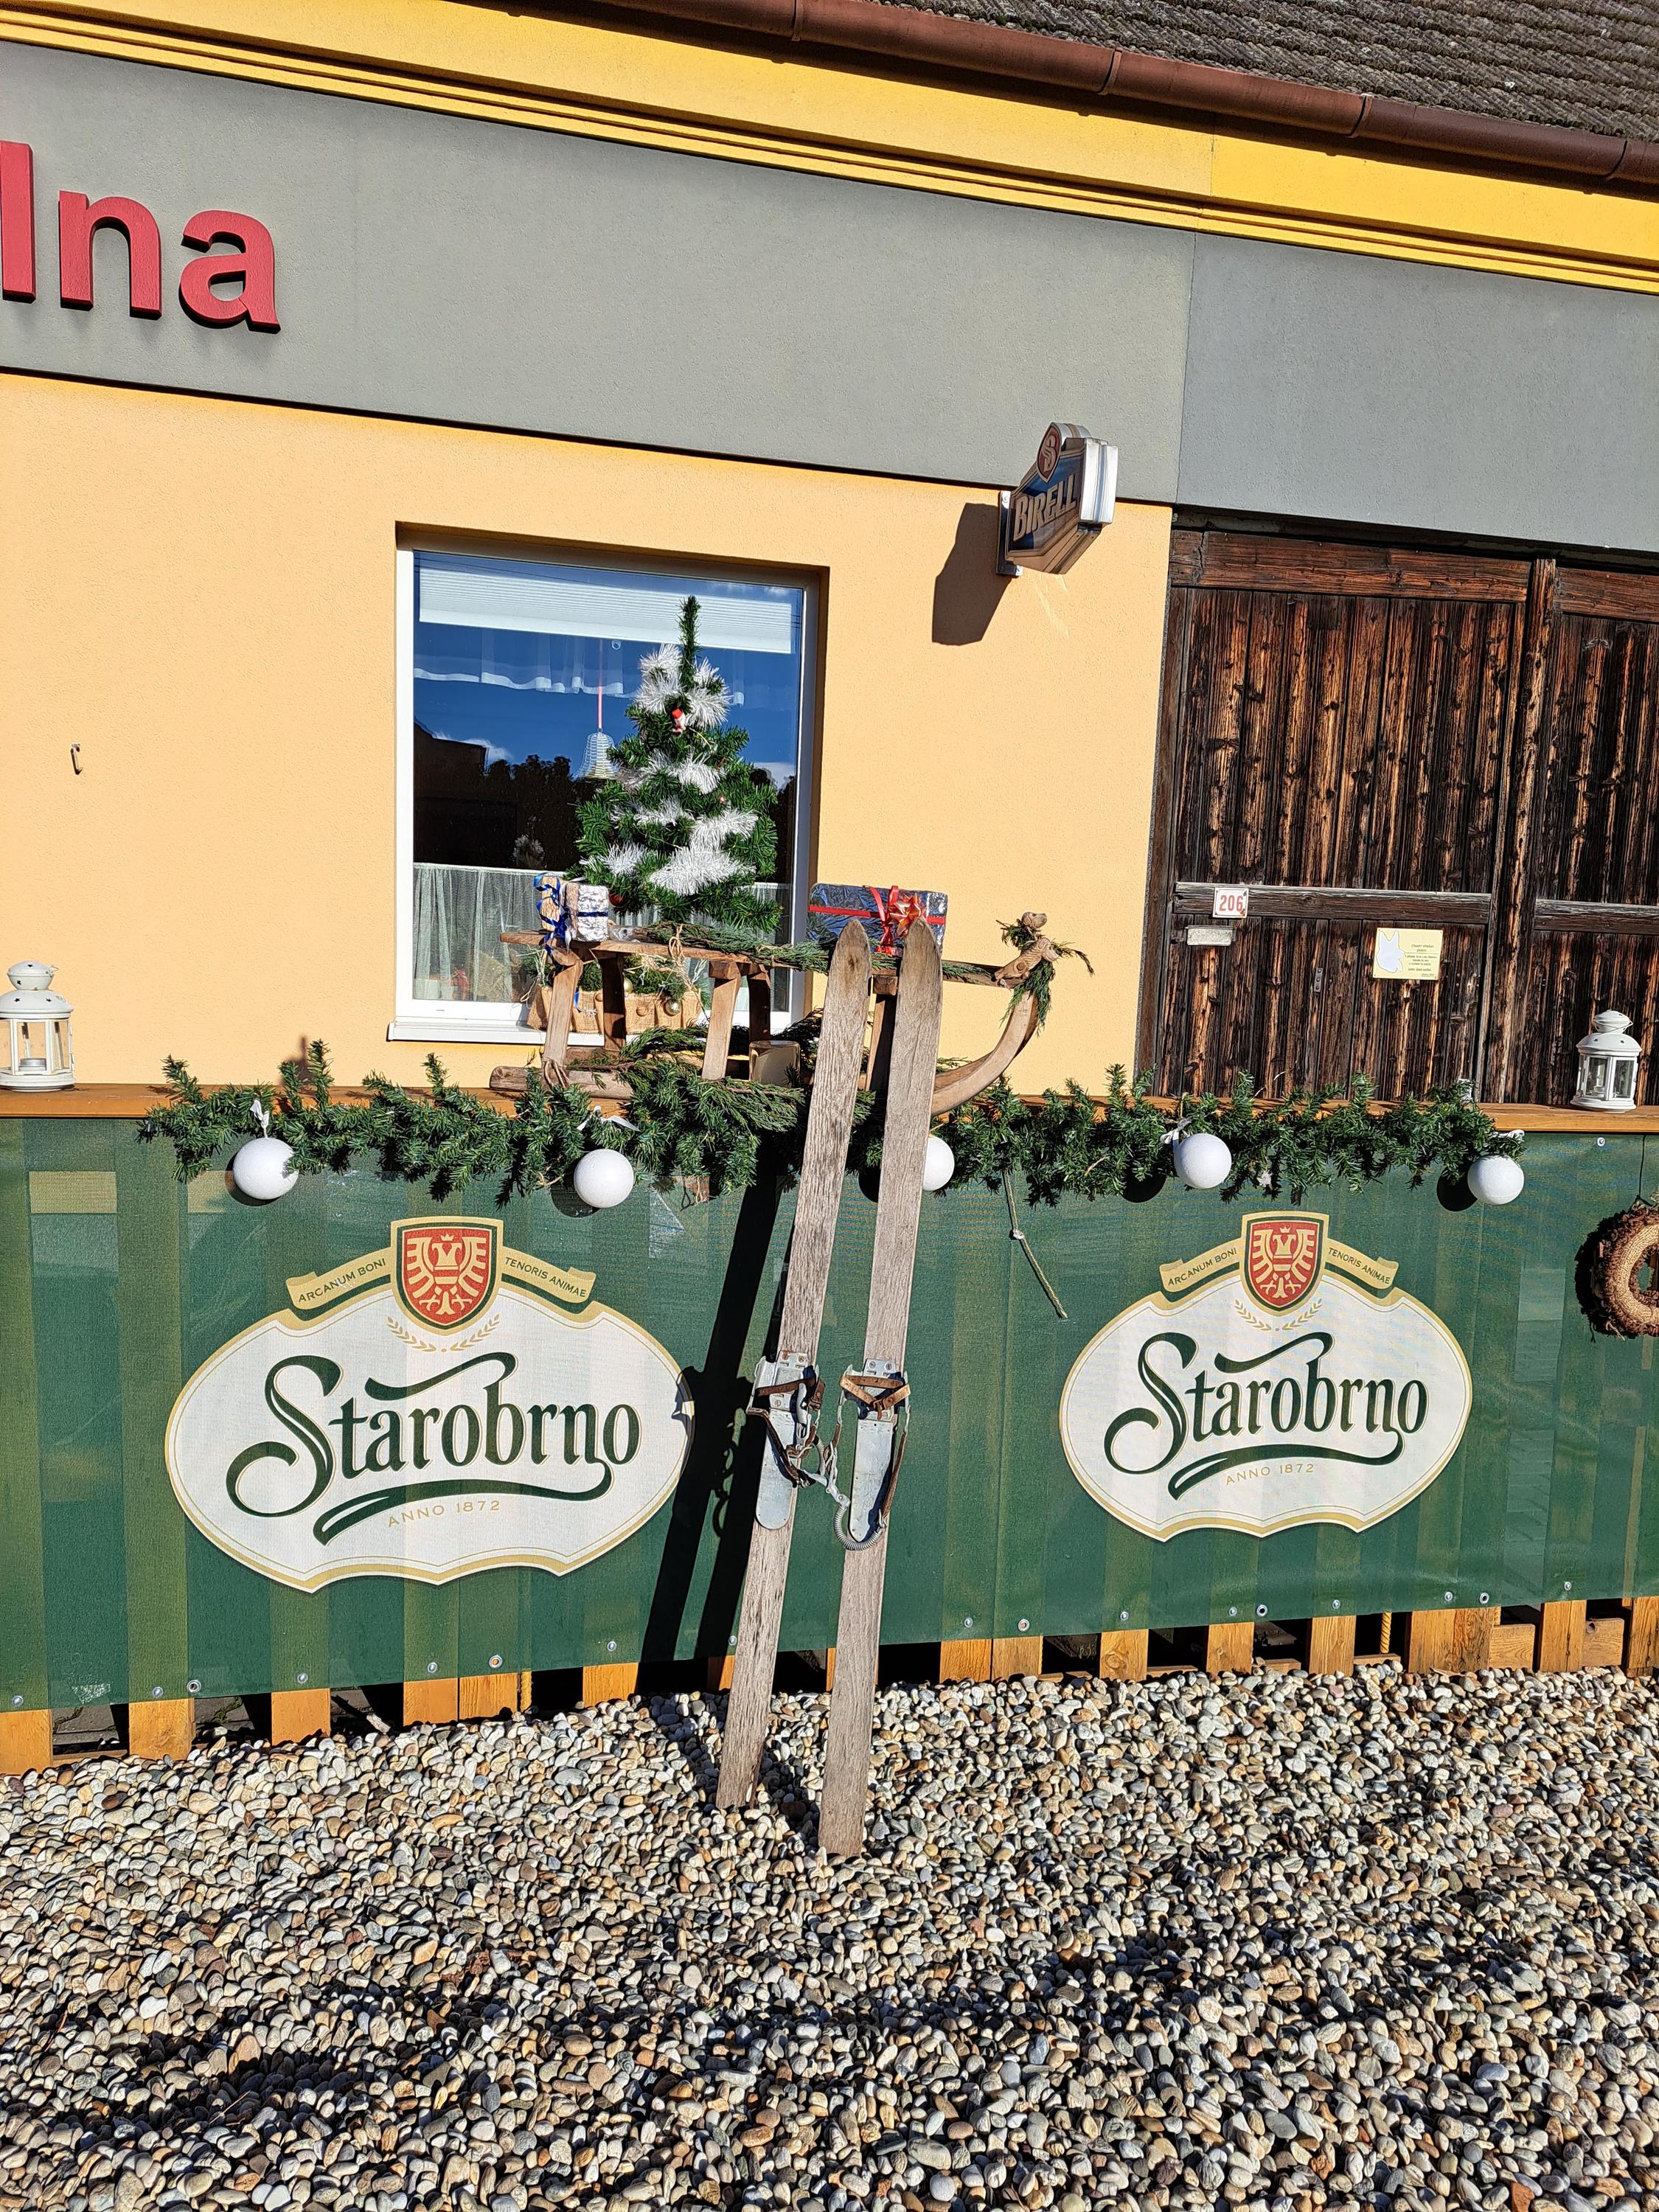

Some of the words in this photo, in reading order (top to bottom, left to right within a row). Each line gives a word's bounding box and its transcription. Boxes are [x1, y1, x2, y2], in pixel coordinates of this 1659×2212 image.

[1013, 474, 1077, 541] BIRELL
[1219, 894, 1243, 911] 206
[298, 1271, 355, 1302] ARCANUM
[357, 1258, 386, 1276] BONI
[505, 1256, 549, 1279] TENORIS
[549, 1276, 587, 1298] ANIMAE
[1168, 1259, 1213, 1286] ARCANUM
[1214, 1247, 1237, 1263] BONI
[1329, 1247, 1362, 1267] TENORIS
[1361, 1265, 1391, 1284] ANIMAE
[1104, 1332, 1428, 1501] Starobrno
[226, 1352, 640, 1546] Starobrno
[1225, 1467, 1271, 1486] ANNO
[1279, 1463, 1314, 1474] 1872
[388, 1505, 445, 1528] ANNO
[456, 1500, 501, 1513] 1872
